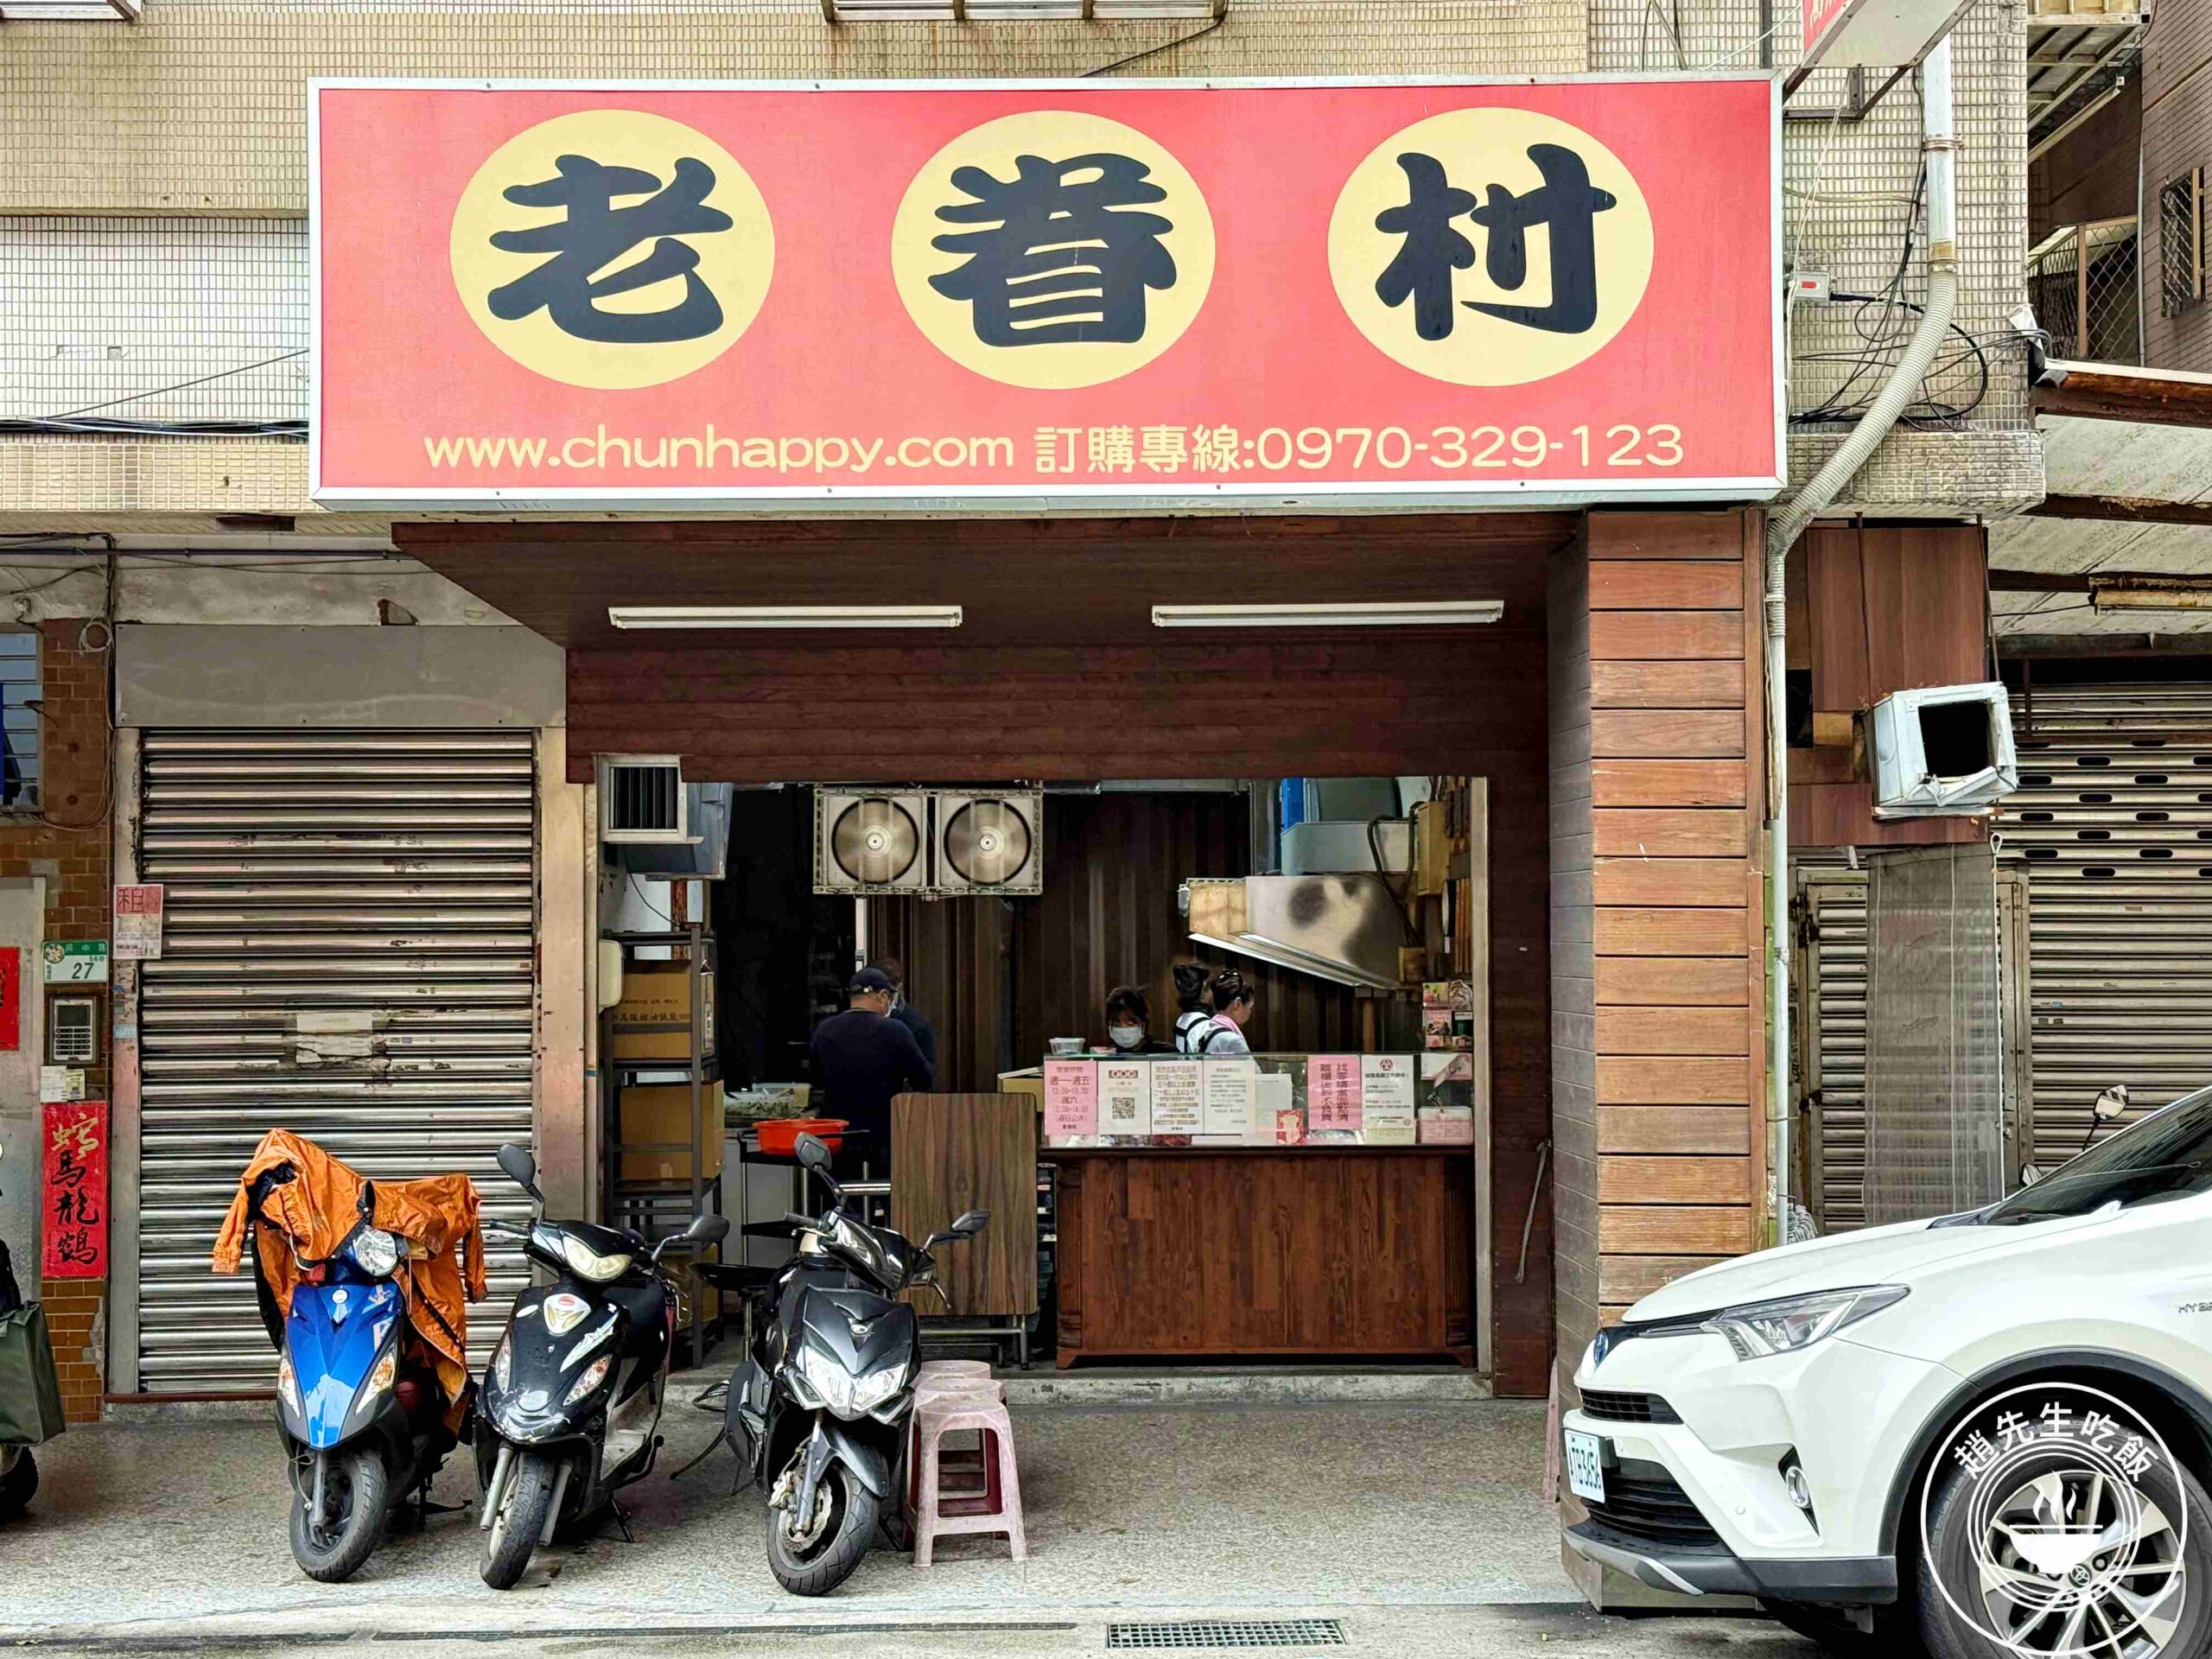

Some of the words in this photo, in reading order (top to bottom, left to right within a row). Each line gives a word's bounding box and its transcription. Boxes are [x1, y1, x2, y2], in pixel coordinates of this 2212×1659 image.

[488, 144, 1617, 348] 老眷村
[423, 423, 1014, 474] www.chunhappy.com
[71, 962, 94, 980] 27
